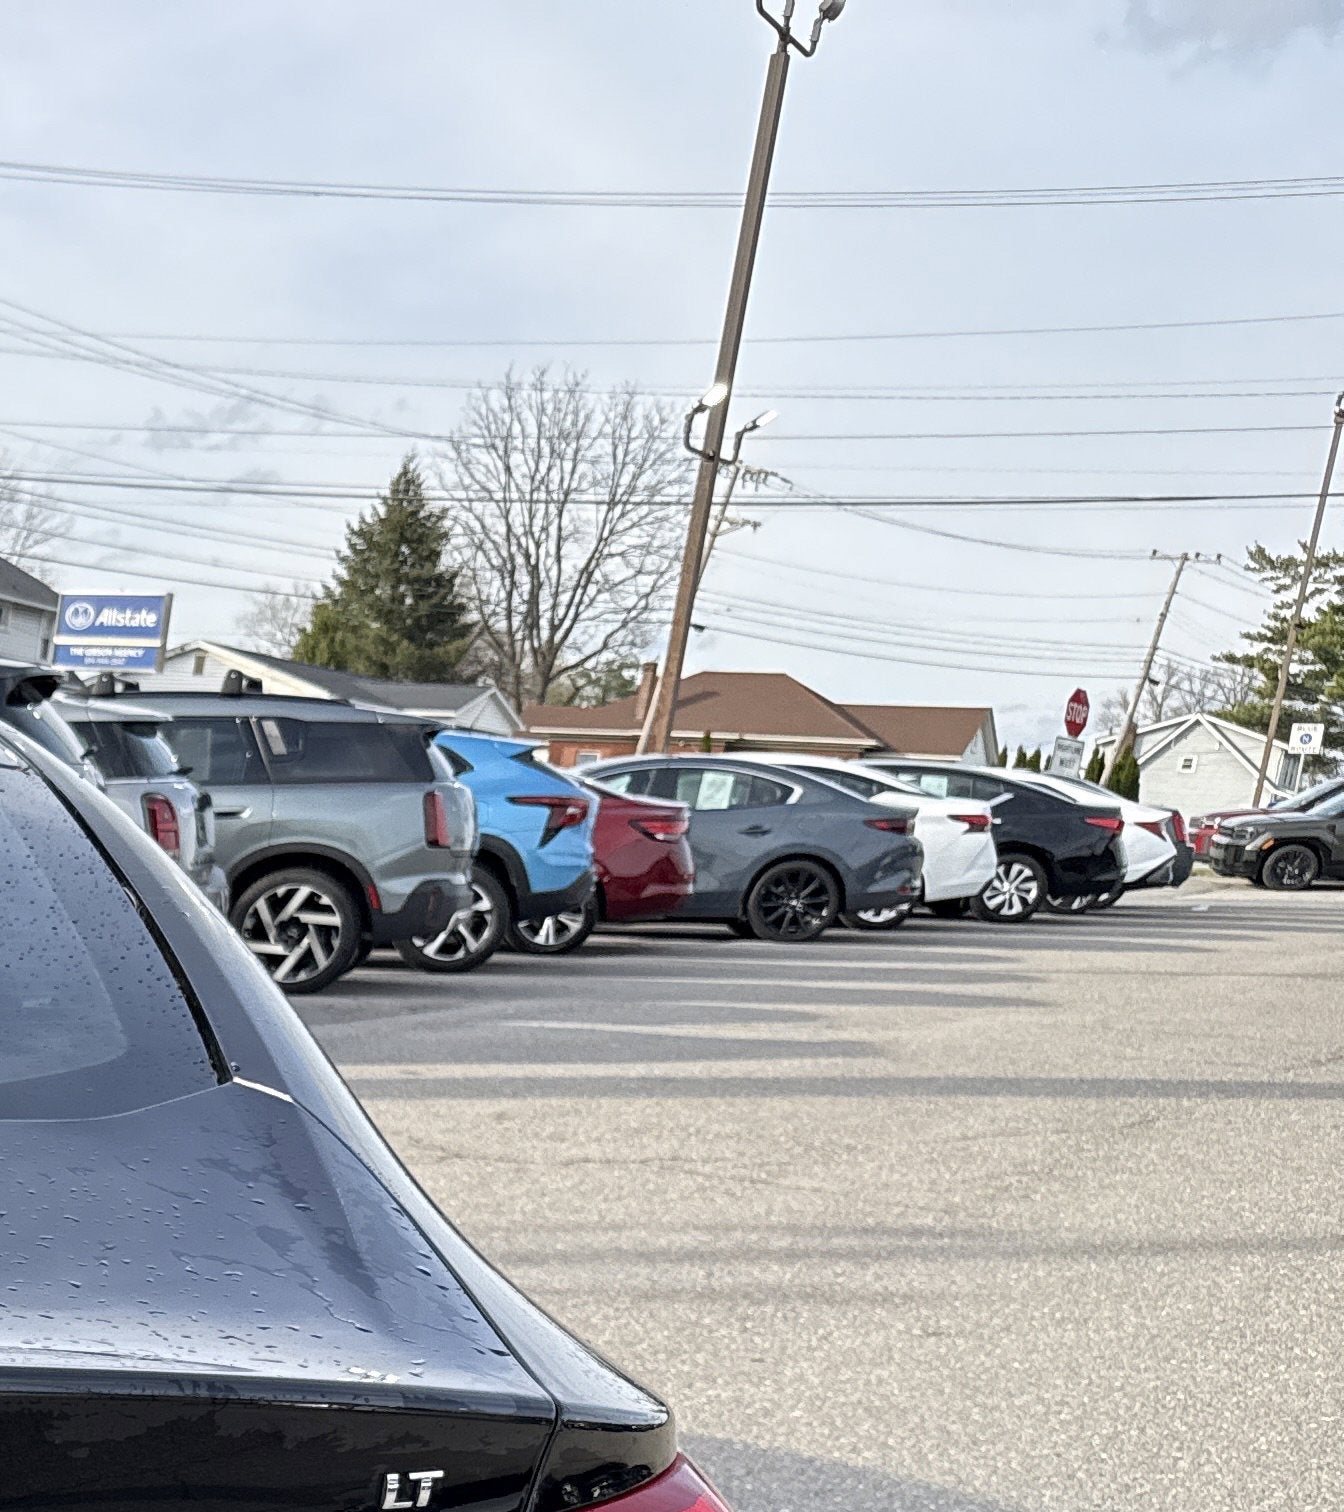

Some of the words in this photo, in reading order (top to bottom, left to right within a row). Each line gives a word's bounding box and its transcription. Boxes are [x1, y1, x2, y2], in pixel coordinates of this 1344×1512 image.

[94, 607, 158, 628] Allstate
[1066, 702, 1088, 724] STOP
[381, 1470, 444, 1510] LT
